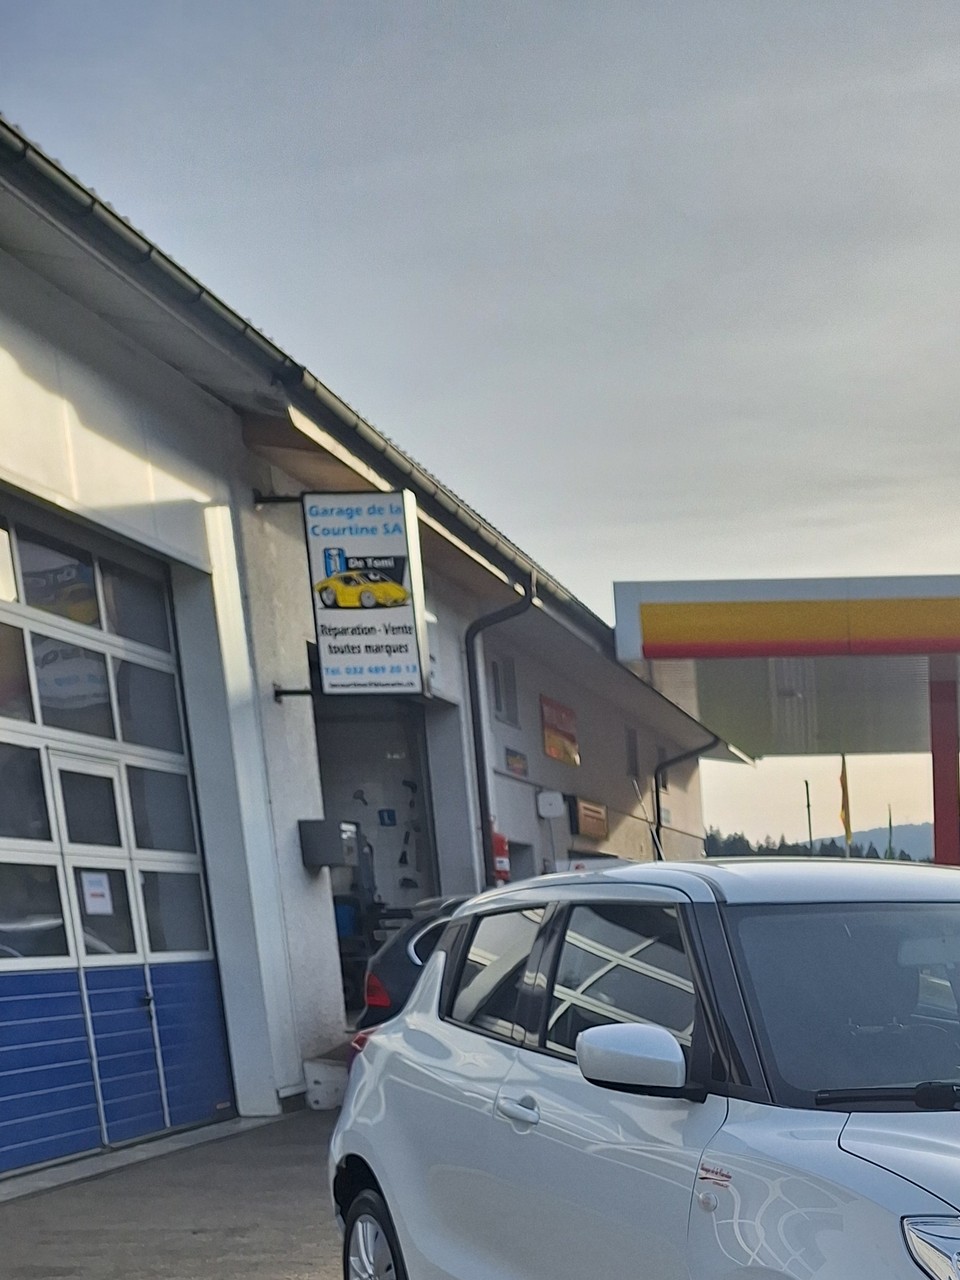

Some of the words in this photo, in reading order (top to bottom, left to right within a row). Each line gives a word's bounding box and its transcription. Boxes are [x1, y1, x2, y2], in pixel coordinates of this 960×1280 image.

[309, 505, 362, 519] Garage
[367, 504, 384, 515] de
[390, 503, 402, 514] la
[310, 525, 378, 536] Courtine
[383, 523, 402, 535] SA
[348, 558, 362, 567] De
[383, 623, 413, 636] Vente
[328, 644, 361, 654] toutes
[364, 644, 409, 657] marques
